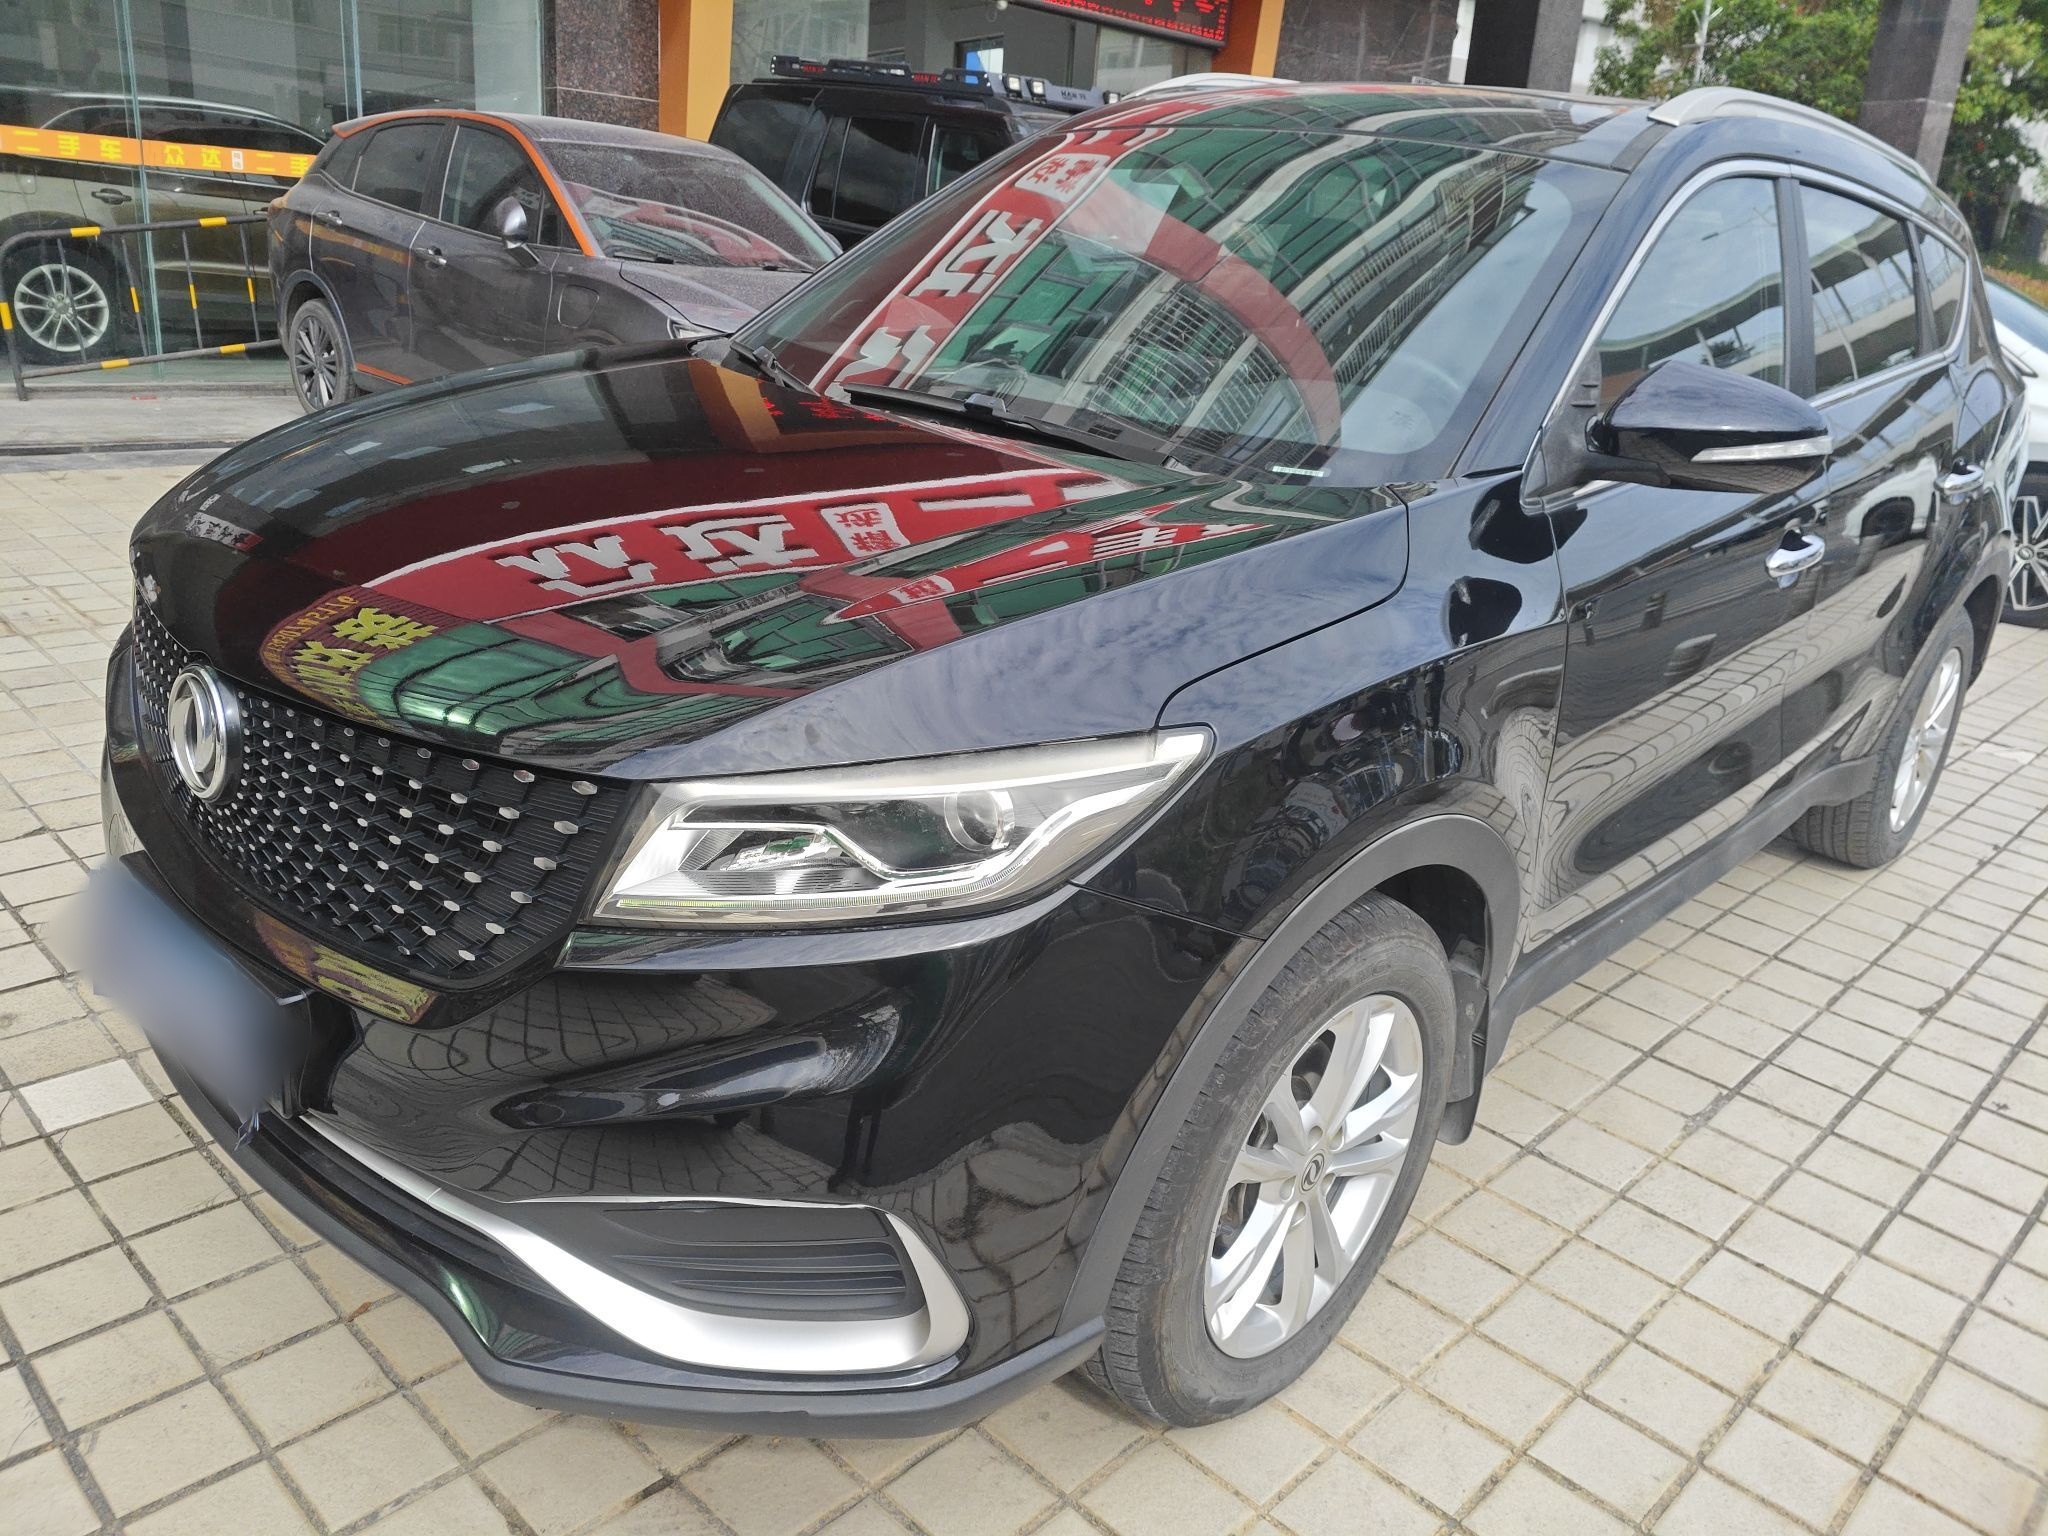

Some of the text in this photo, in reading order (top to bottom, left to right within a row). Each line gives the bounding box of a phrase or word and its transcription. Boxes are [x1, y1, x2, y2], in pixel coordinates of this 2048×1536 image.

[13, 129, 122, 160] 二手车
[164, 144, 222, 168] 众达
